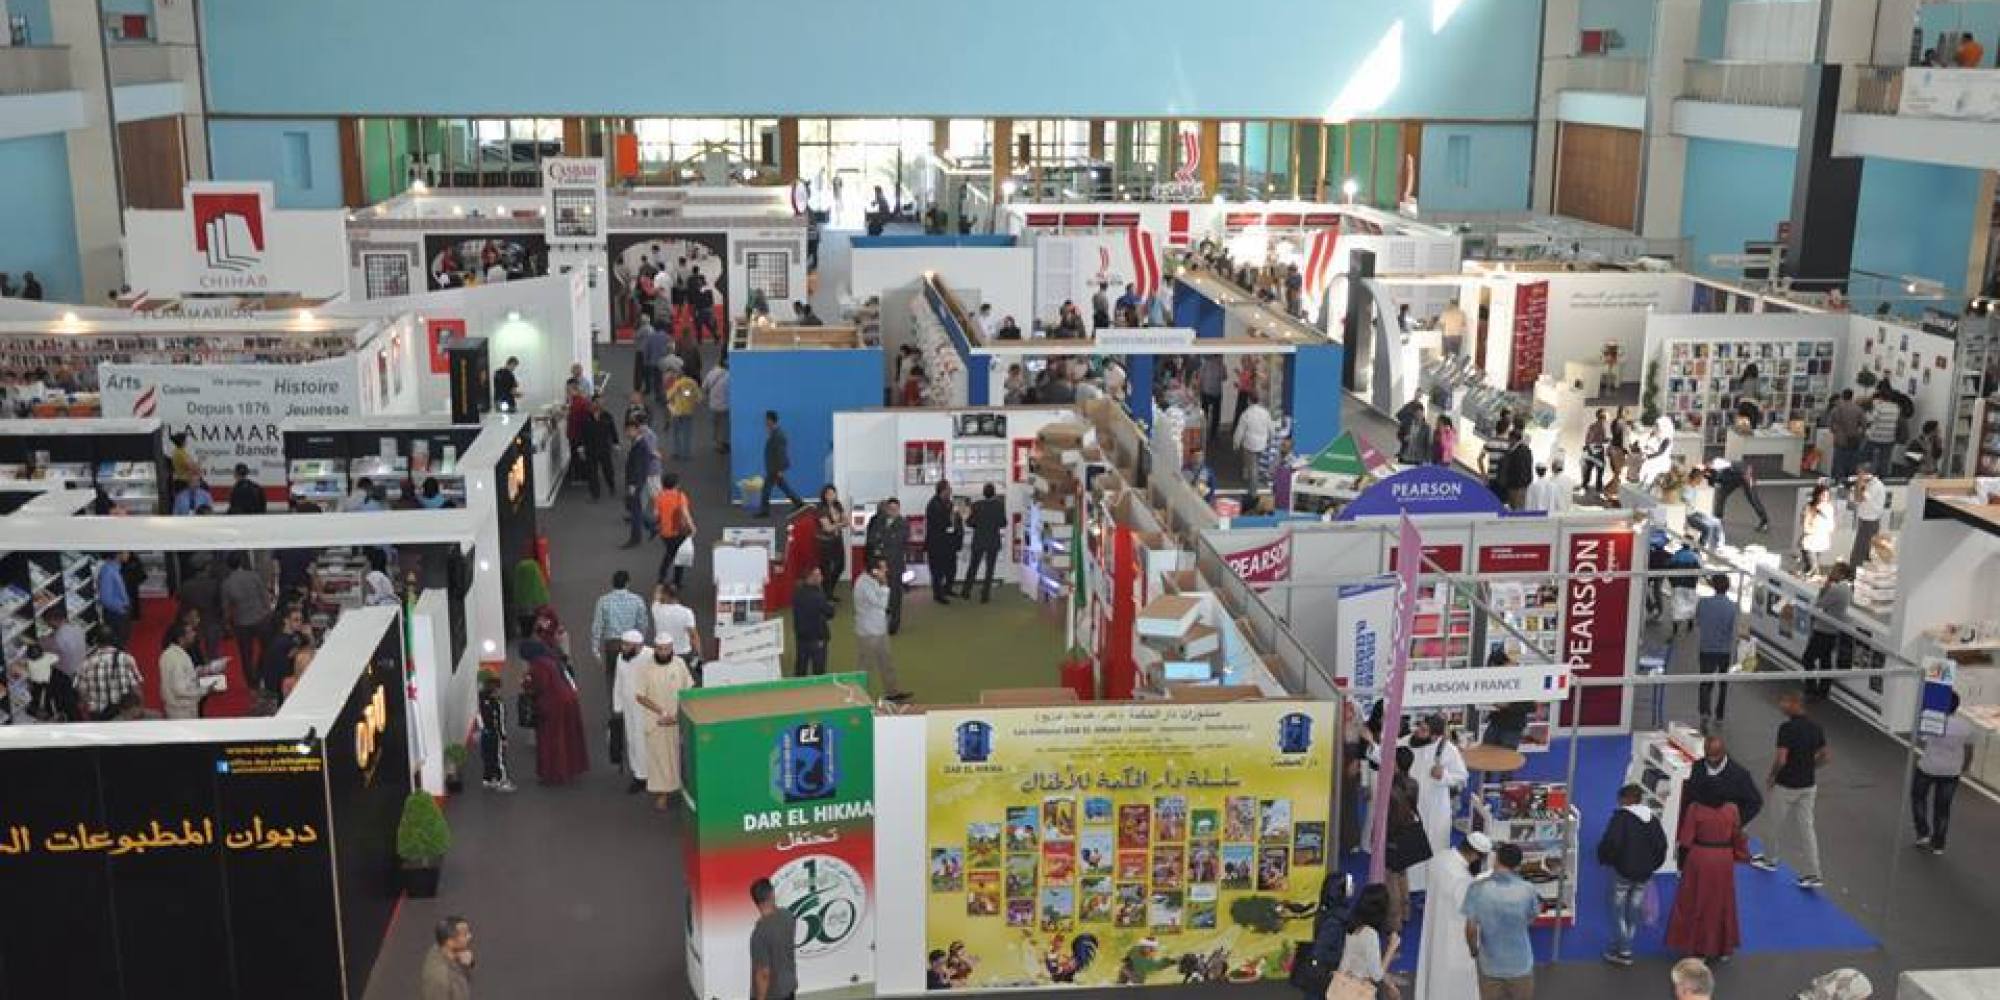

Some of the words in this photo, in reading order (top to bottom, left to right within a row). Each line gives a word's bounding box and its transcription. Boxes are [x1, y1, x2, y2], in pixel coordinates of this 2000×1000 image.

[200, 275, 267, 288] CHIHAB
[106, 374, 141, 390] Arts
[274, 378, 339, 394] Histoire
[186, 401, 234, 417] Depuis
[239, 401, 270, 415] 1876
[285, 404, 349, 416] Jeunesse
[1391, 482, 1463, 497] PEARSON
[1569, 539, 1600, 670] PEARSON
[1412, 681, 1470, 695] PEARSON
[1474, 678, 1521, 692] FRANCE
[743, 811, 783, 832] DAR
[787, 807, 809, 826] EL
[814, 799, 874, 823] HIKMA
[45, 816, 213, 855] المطبوعات
[226, 816, 318, 849] ديوان
